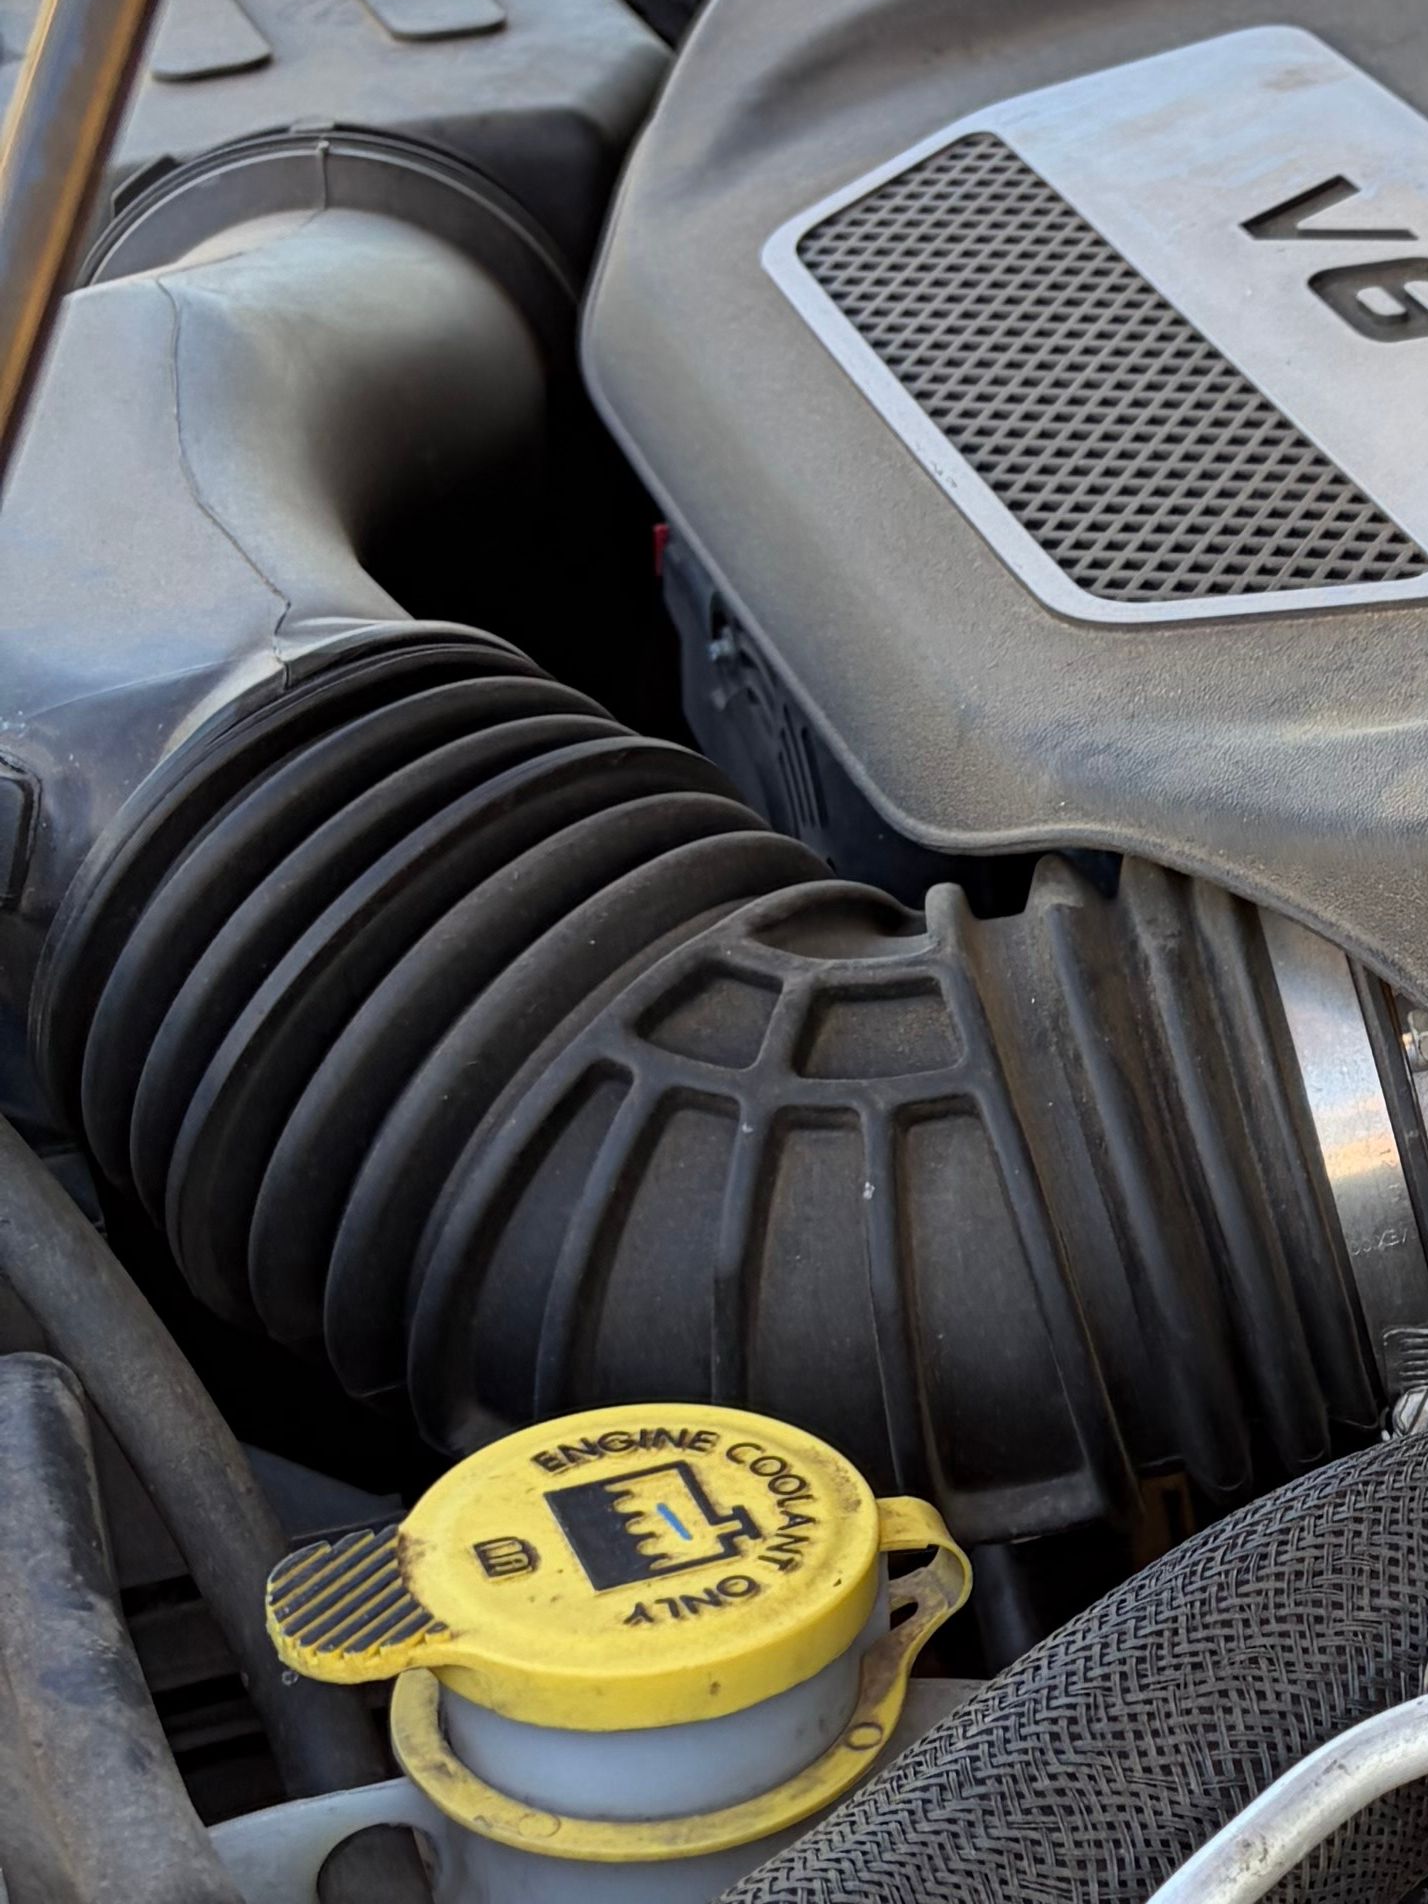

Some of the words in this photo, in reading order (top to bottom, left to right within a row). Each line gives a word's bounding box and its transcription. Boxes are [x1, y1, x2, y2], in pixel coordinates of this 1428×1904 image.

[530, 1427, 720, 1474] ENGINE
[725, 1442, 818, 1573] COOLANT
[623, 1574, 761, 1625] ONLY
